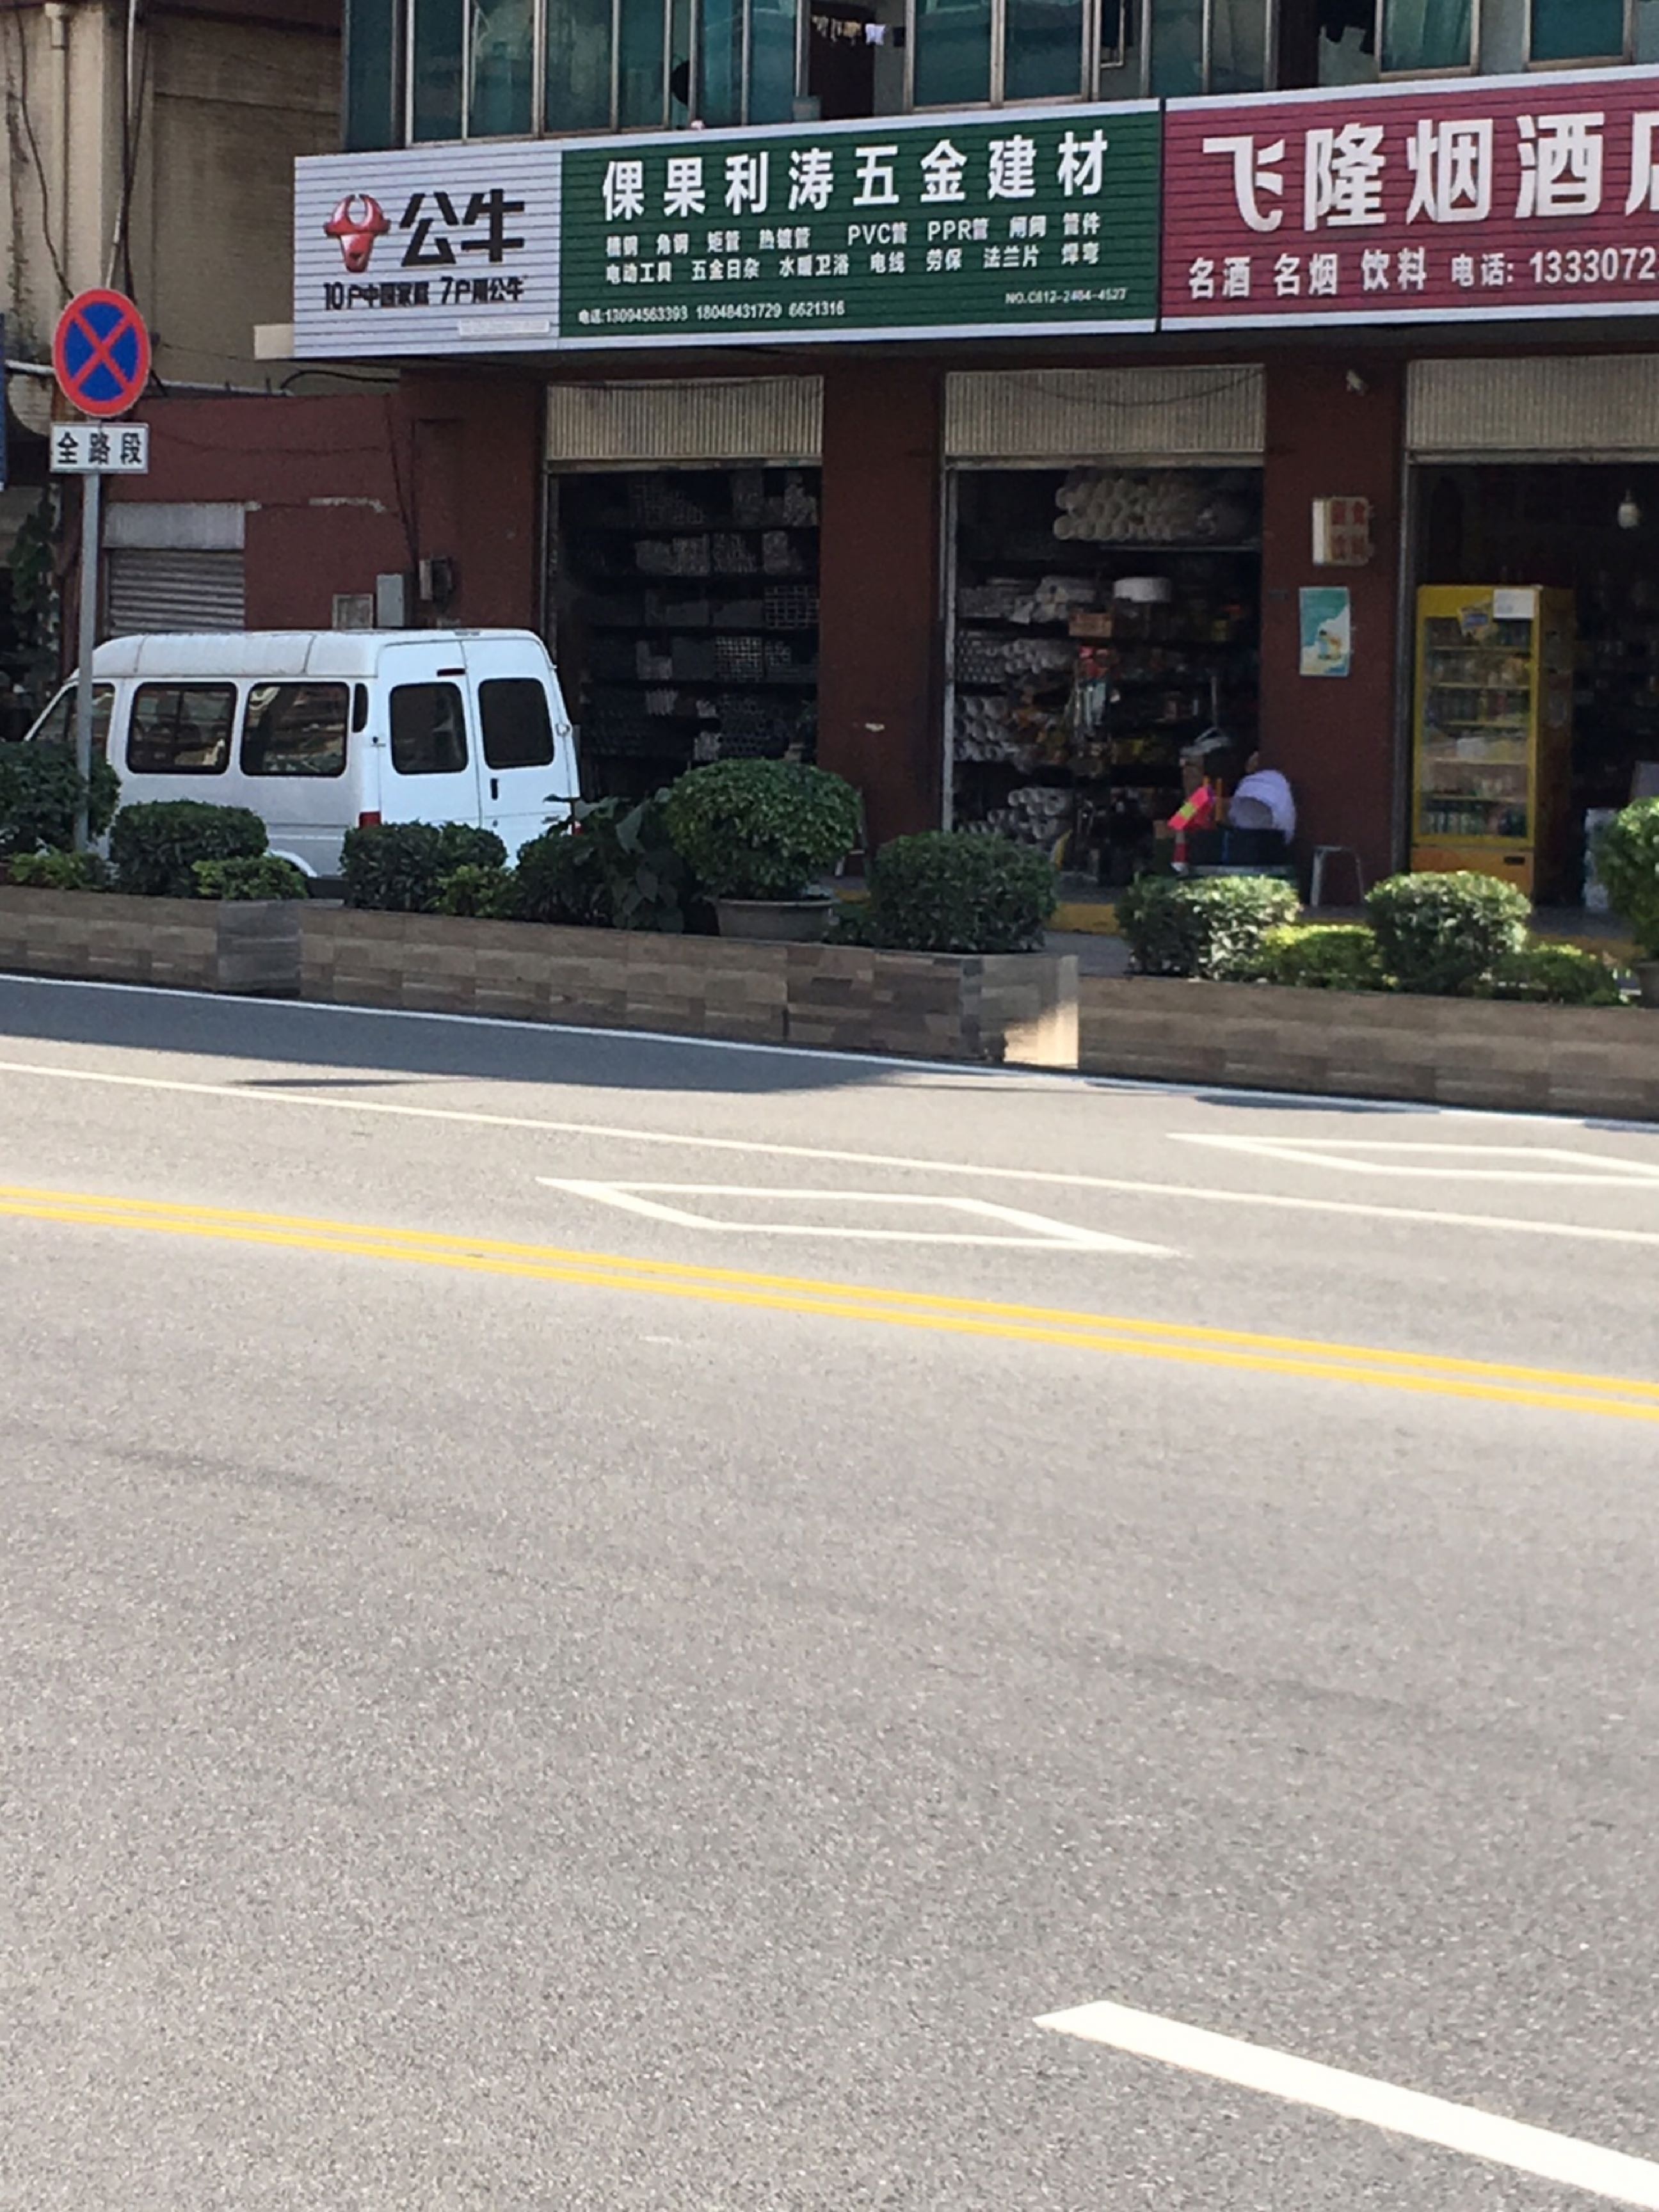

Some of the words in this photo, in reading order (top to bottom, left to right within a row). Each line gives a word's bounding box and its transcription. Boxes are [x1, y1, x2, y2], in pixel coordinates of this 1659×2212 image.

[602, 129, 1109, 221] 倮果利涛五金建材
[399, 188, 525, 268] 公牛
[847, 221, 908, 246] PVC管
[927, 217, 990, 242] PPR管
[1063, 211, 1101, 236] 管件
[605, 260, 673, 285] 电动工具
[691, 257, 761, 281] 五金日杂
[779, 253, 850, 278] 水暖卫浴
[870, 250, 905, 274] 电线
[926, 247, 963, 273] 劳保
[982, 243, 1040, 269] 法兰片
[1189, 257, 1251, 300] 名酒
[1274, 253, 1339, 297] 名烟
[1361, 246, 1427, 291] 饮料
[56, 431, 143, 465] 全路段
